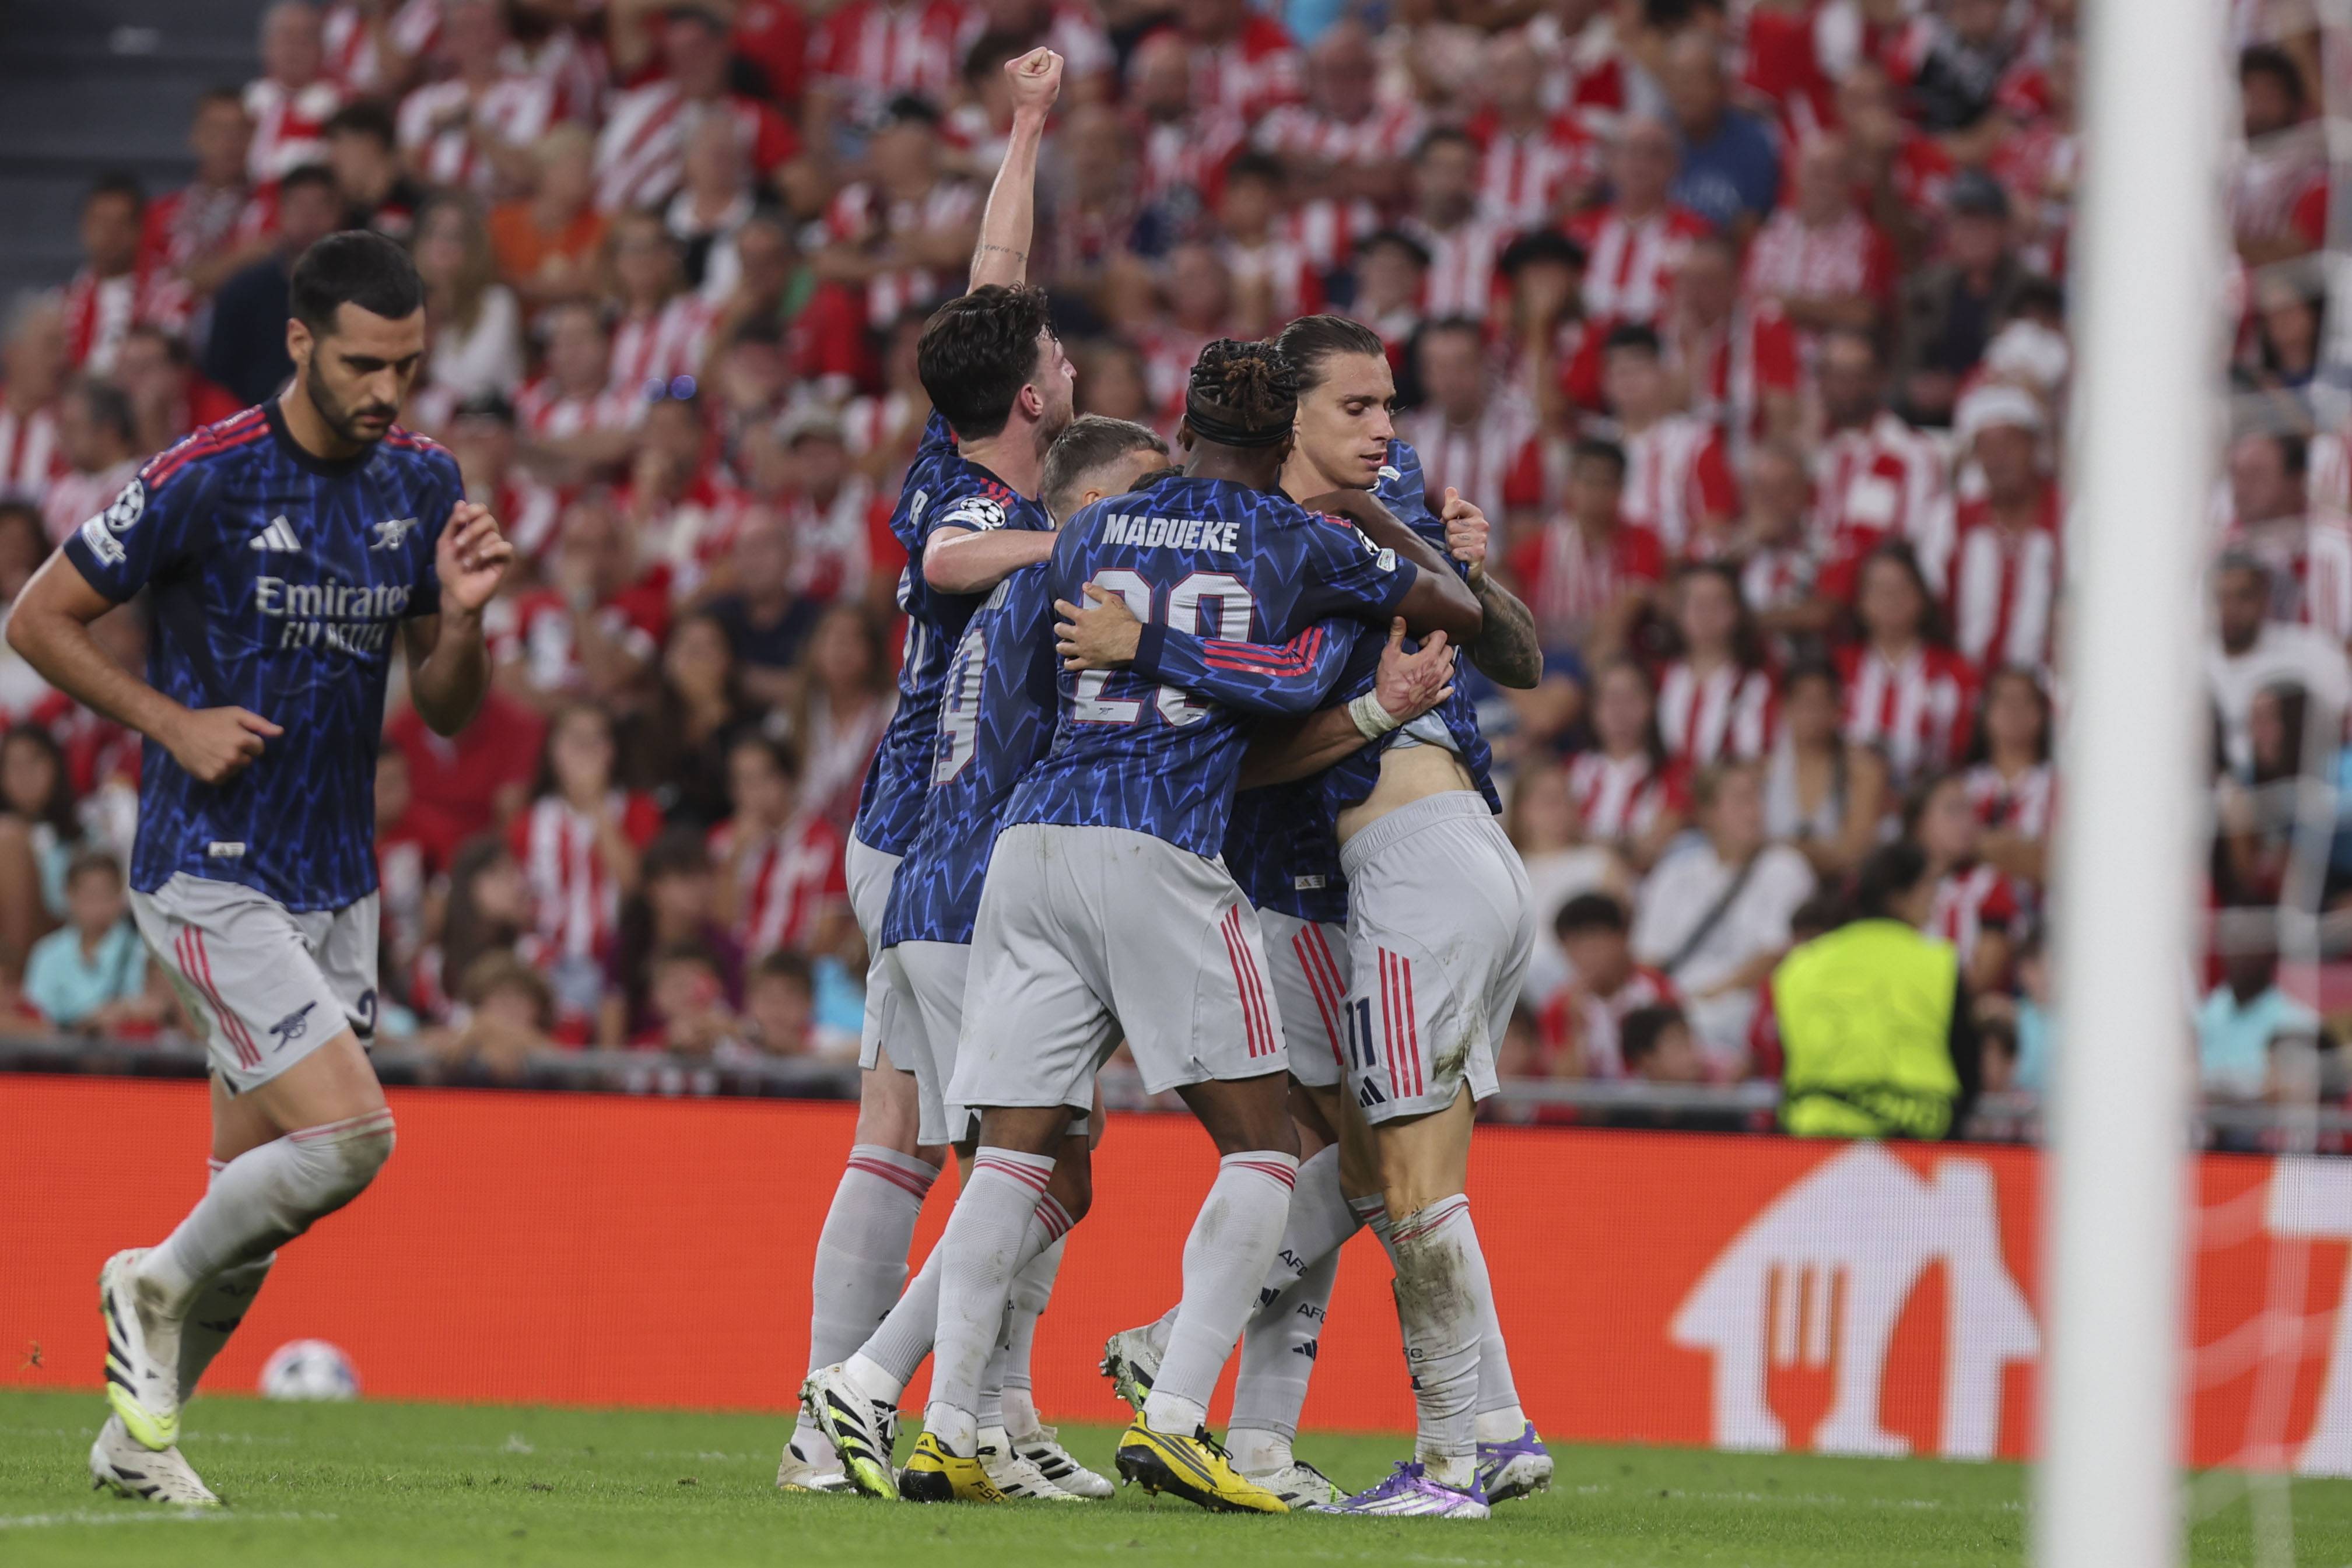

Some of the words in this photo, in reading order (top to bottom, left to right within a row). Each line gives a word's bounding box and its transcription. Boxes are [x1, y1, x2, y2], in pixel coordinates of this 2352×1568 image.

[1101, 514, 1240, 553] MADUEKE
[255, 575, 412, 617] Emirates
[1345, 995, 1376, 1071] 11
[1278, 1249, 1308, 1277] AFC
